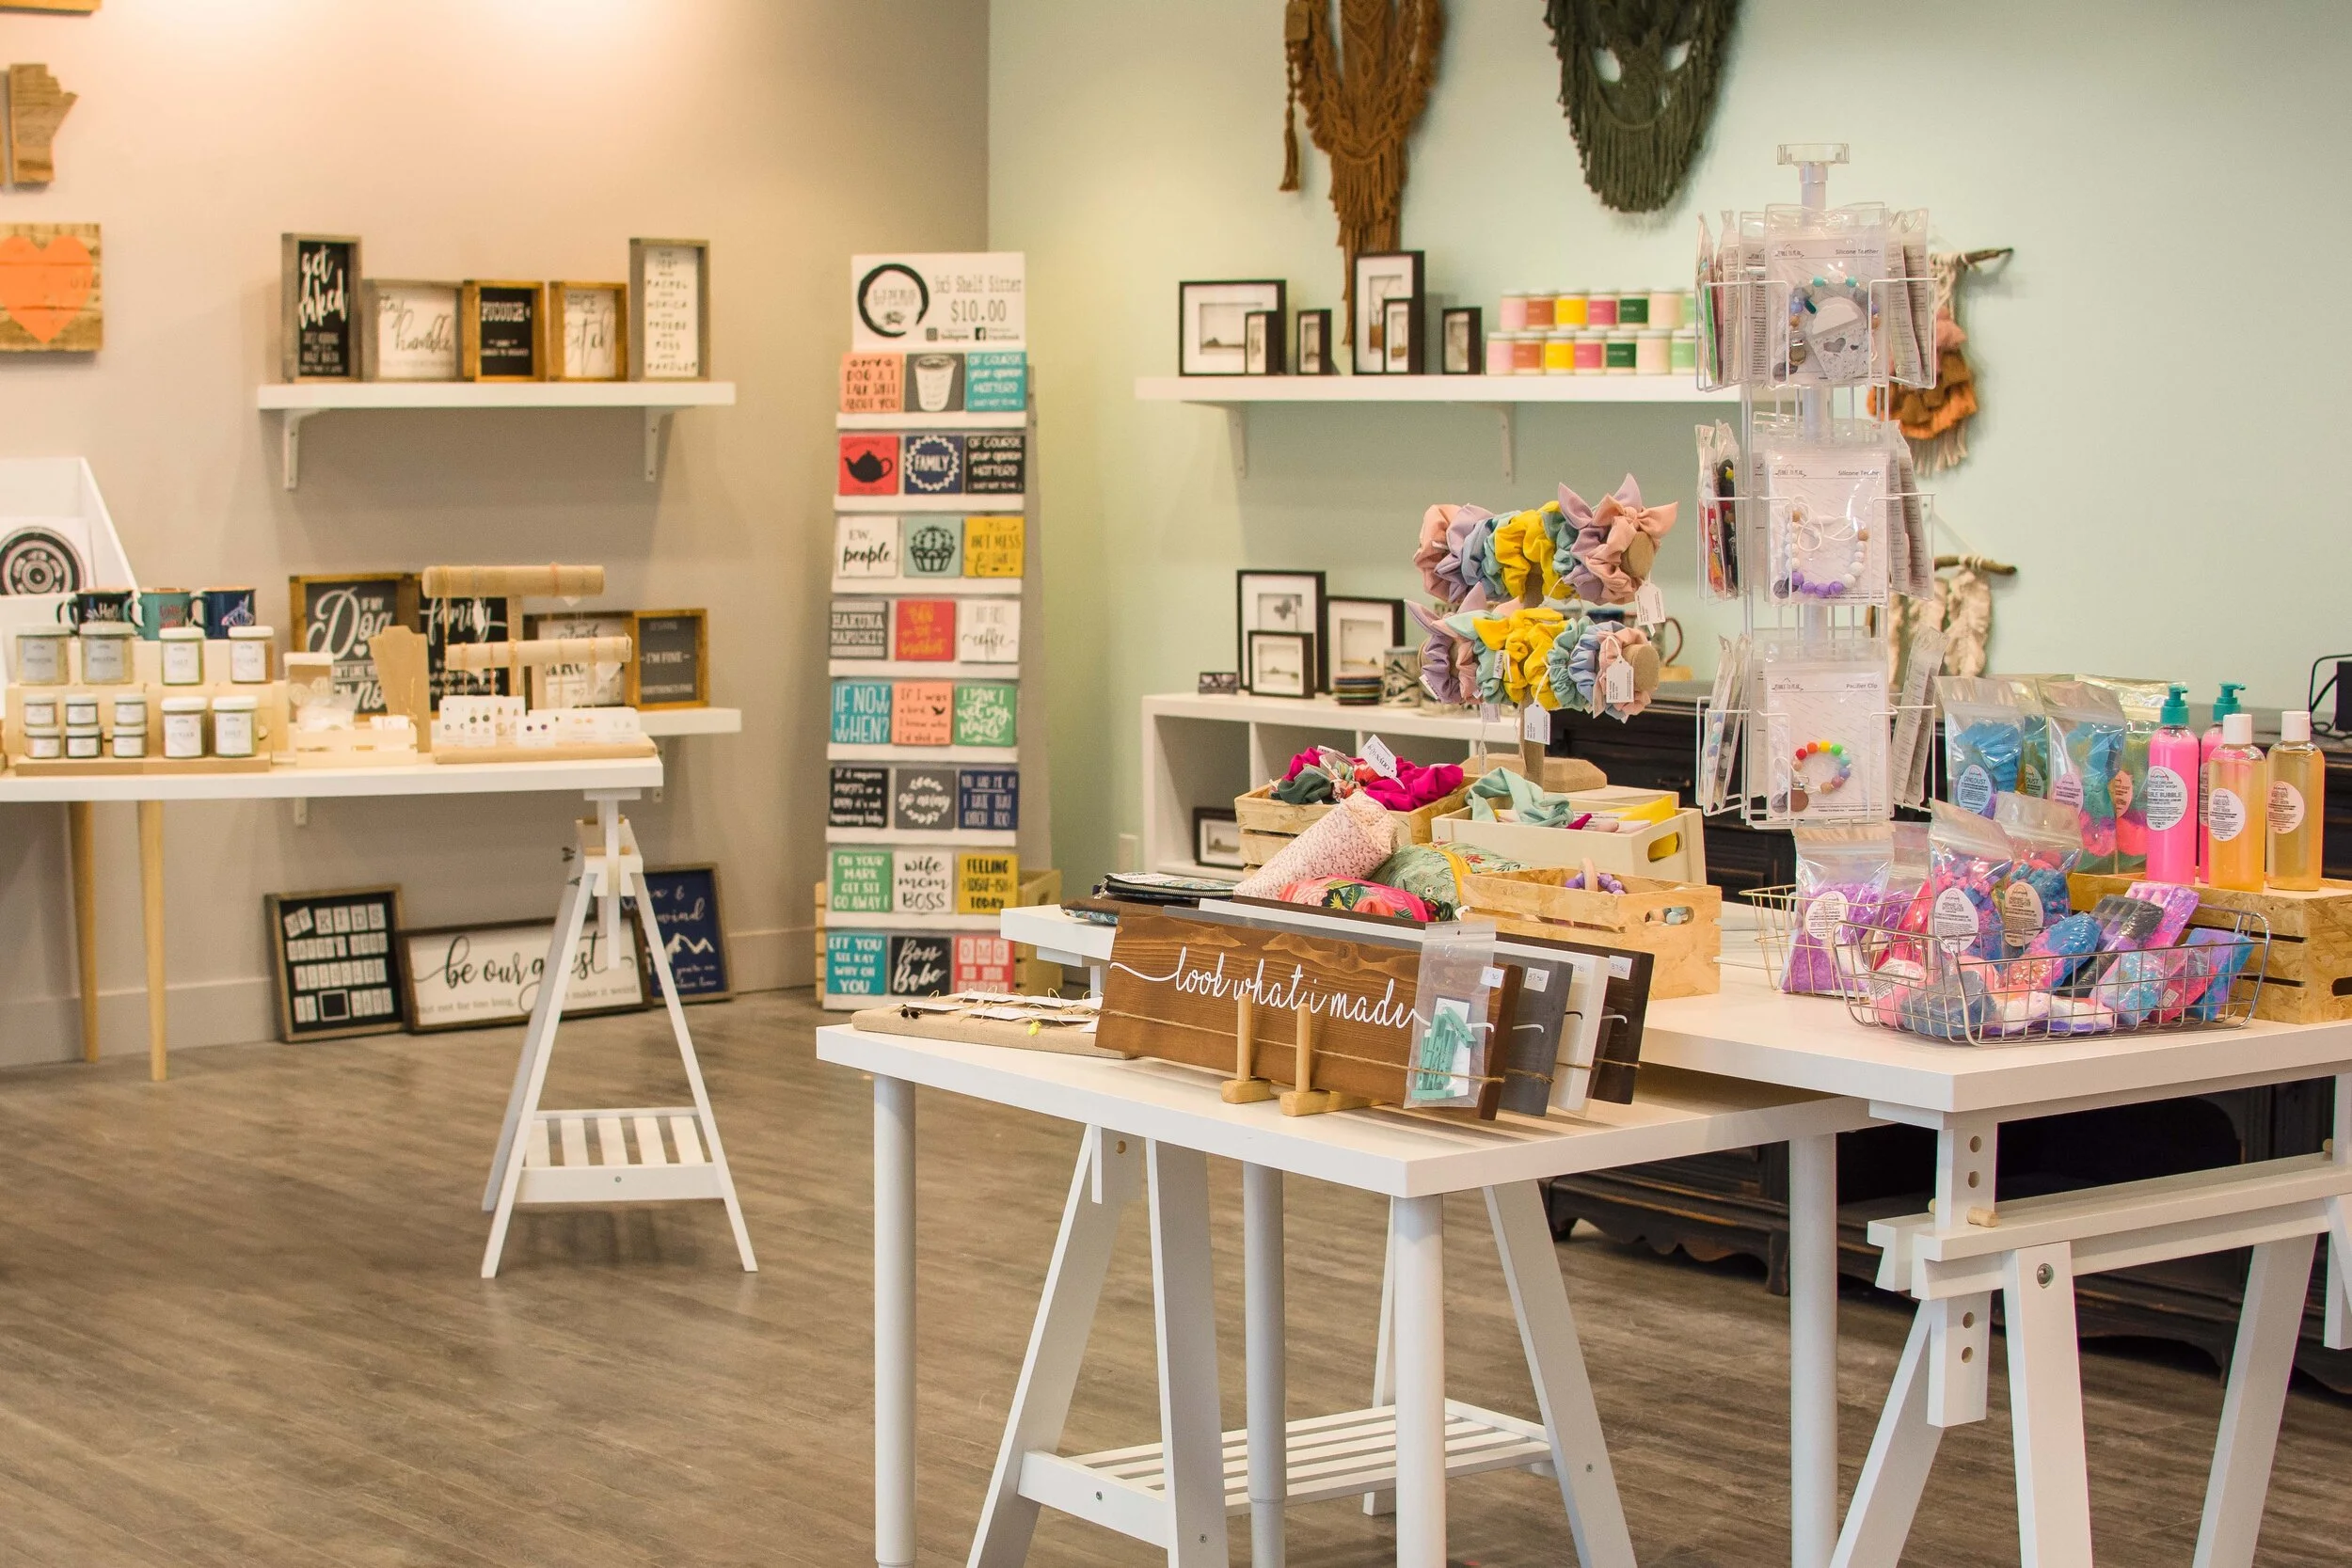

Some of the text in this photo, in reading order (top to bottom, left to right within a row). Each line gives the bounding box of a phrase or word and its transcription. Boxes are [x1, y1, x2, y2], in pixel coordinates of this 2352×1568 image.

[950, 299, 1006, 324] $10.00
[914, 454, 950, 472] FAMILY
[842, 542, 892, 571] people
[835, 687, 850, 713] IF
[844, 868, 878, 879] MARK
[904, 856, 945, 874] wife
[966, 859, 1009, 874] FEELING
[841, 882, 859, 894] GET
[898, 877, 949, 891] mom
[834, 895, 850, 910] GO
[852, 895, 882, 910] AWAY
[902, 893, 946, 910] BOSS
[970, 896, 1004, 909] TODAY
[855, 937, 882, 951] YOU
[426, 936, 479, 989] be
[483, 952, 528, 985] our
[839, 979, 870, 993] YOU
[894, 963, 947, 993] Babe
[1234, 958, 1307, 1012] what
[1311, 978, 1327, 1014] i
[1330, 978, 1420, 1029] made
